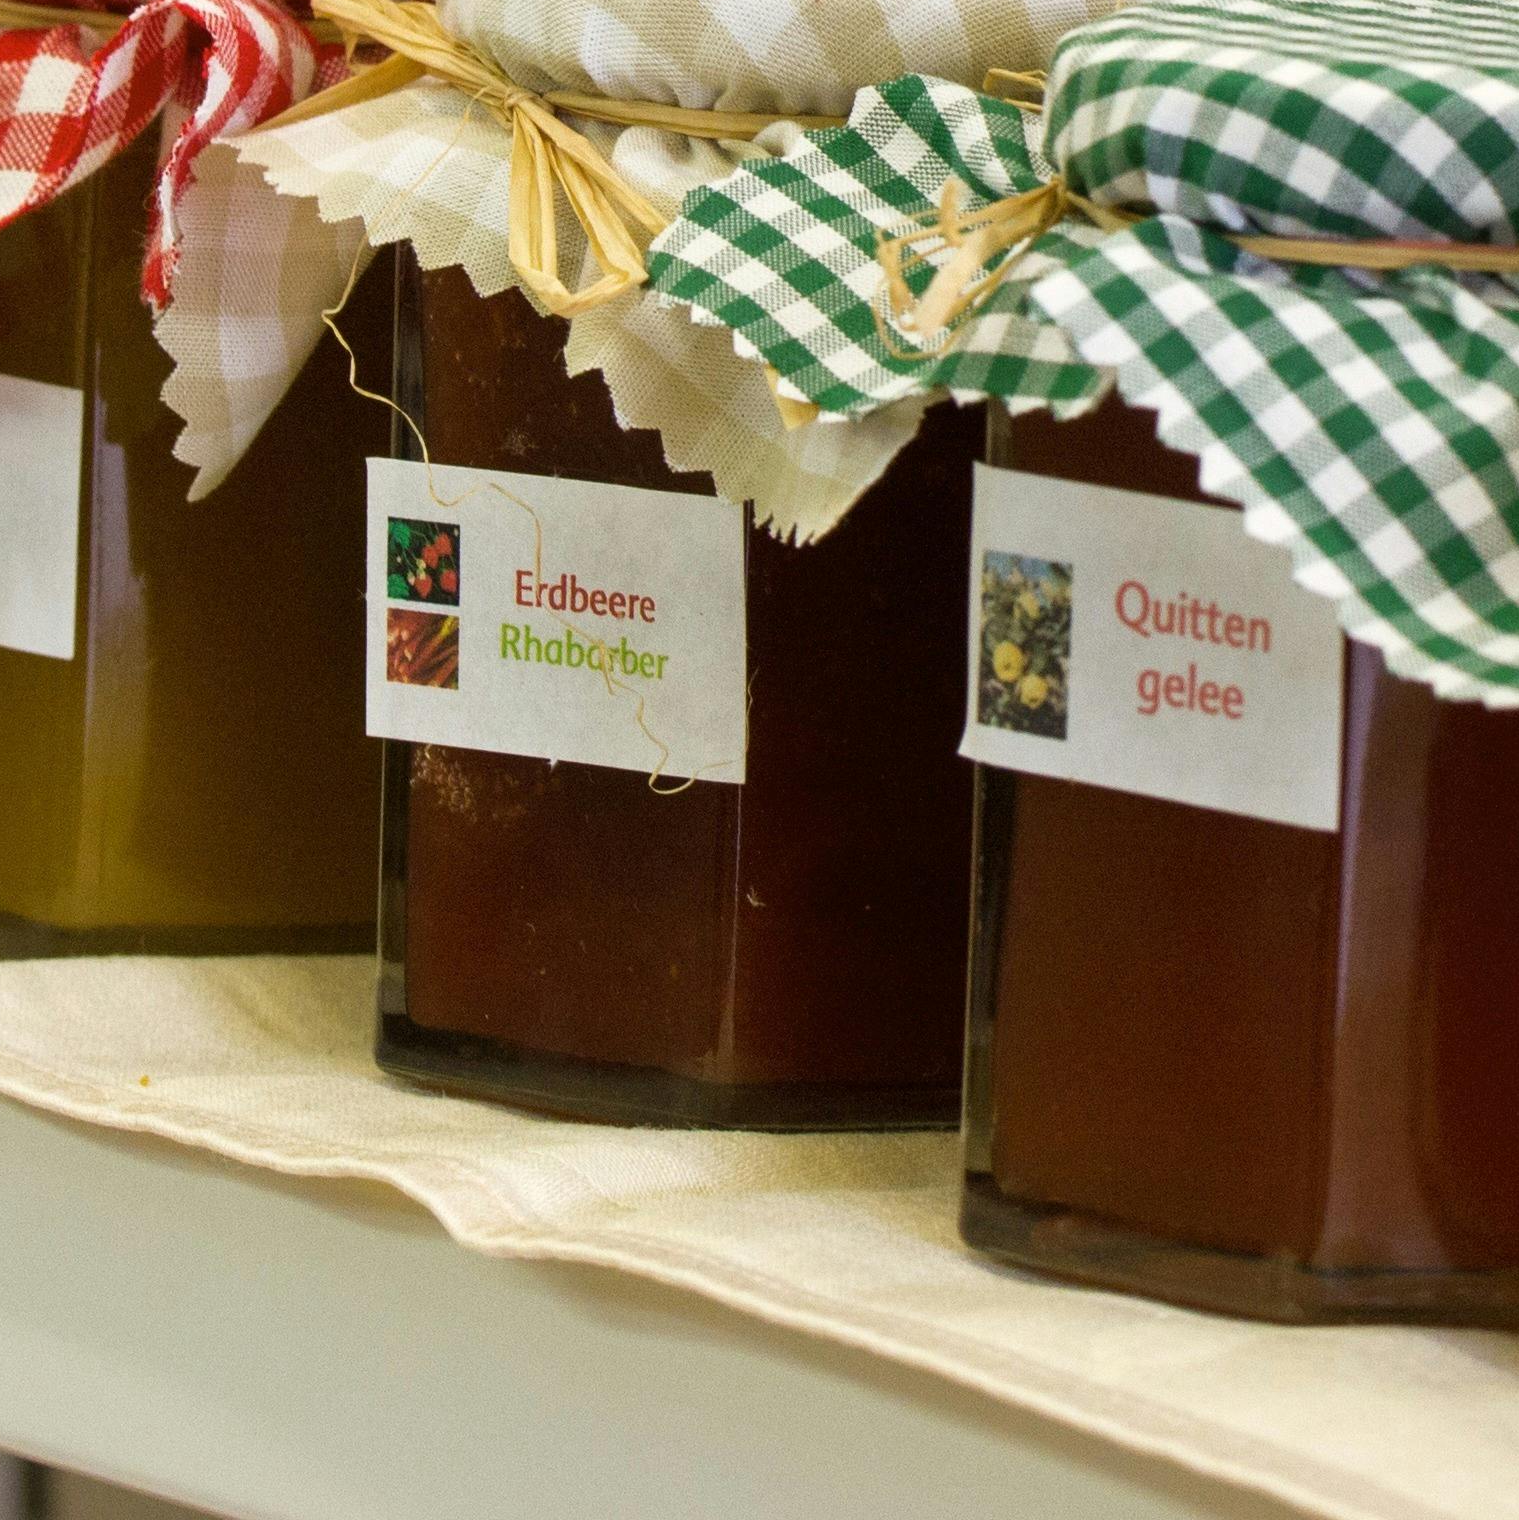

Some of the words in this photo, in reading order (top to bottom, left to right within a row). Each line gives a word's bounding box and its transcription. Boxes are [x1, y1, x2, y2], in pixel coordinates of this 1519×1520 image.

[514, 569, 657, 623] Erdbeere
[1114, 579, 1274, 654] Quitten
[499, 622, 669, 680] Rhabarber
[1135, 661, 1246, 720] gelee
